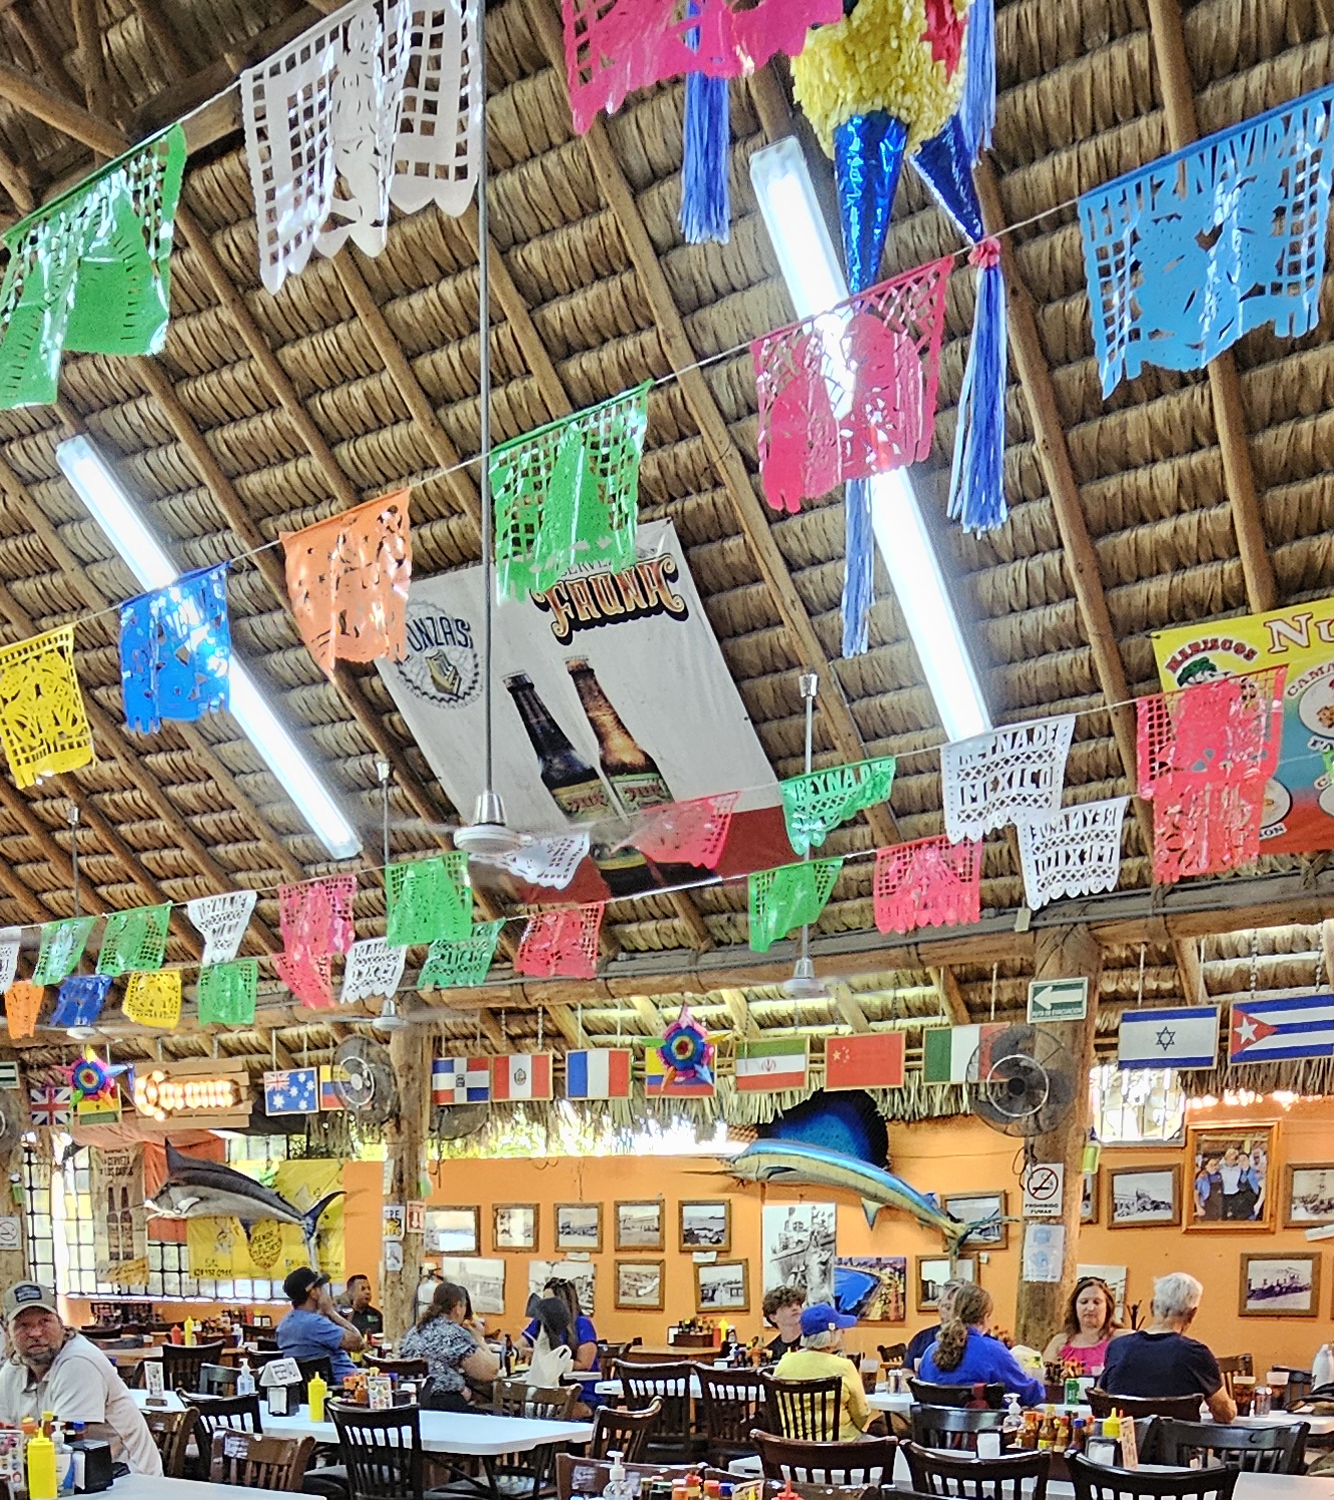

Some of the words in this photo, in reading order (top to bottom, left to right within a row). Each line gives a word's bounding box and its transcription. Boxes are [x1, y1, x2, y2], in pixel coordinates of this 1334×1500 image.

[1087, 172, 1180, 243] FELIZ
[1184, 99, 1334, 197] NAVIDAD
[531, 552, 688, 645] FAUNA
[794, 766, 859, 803] REYNA
[958, 765, 1056, 807] MEXICO
